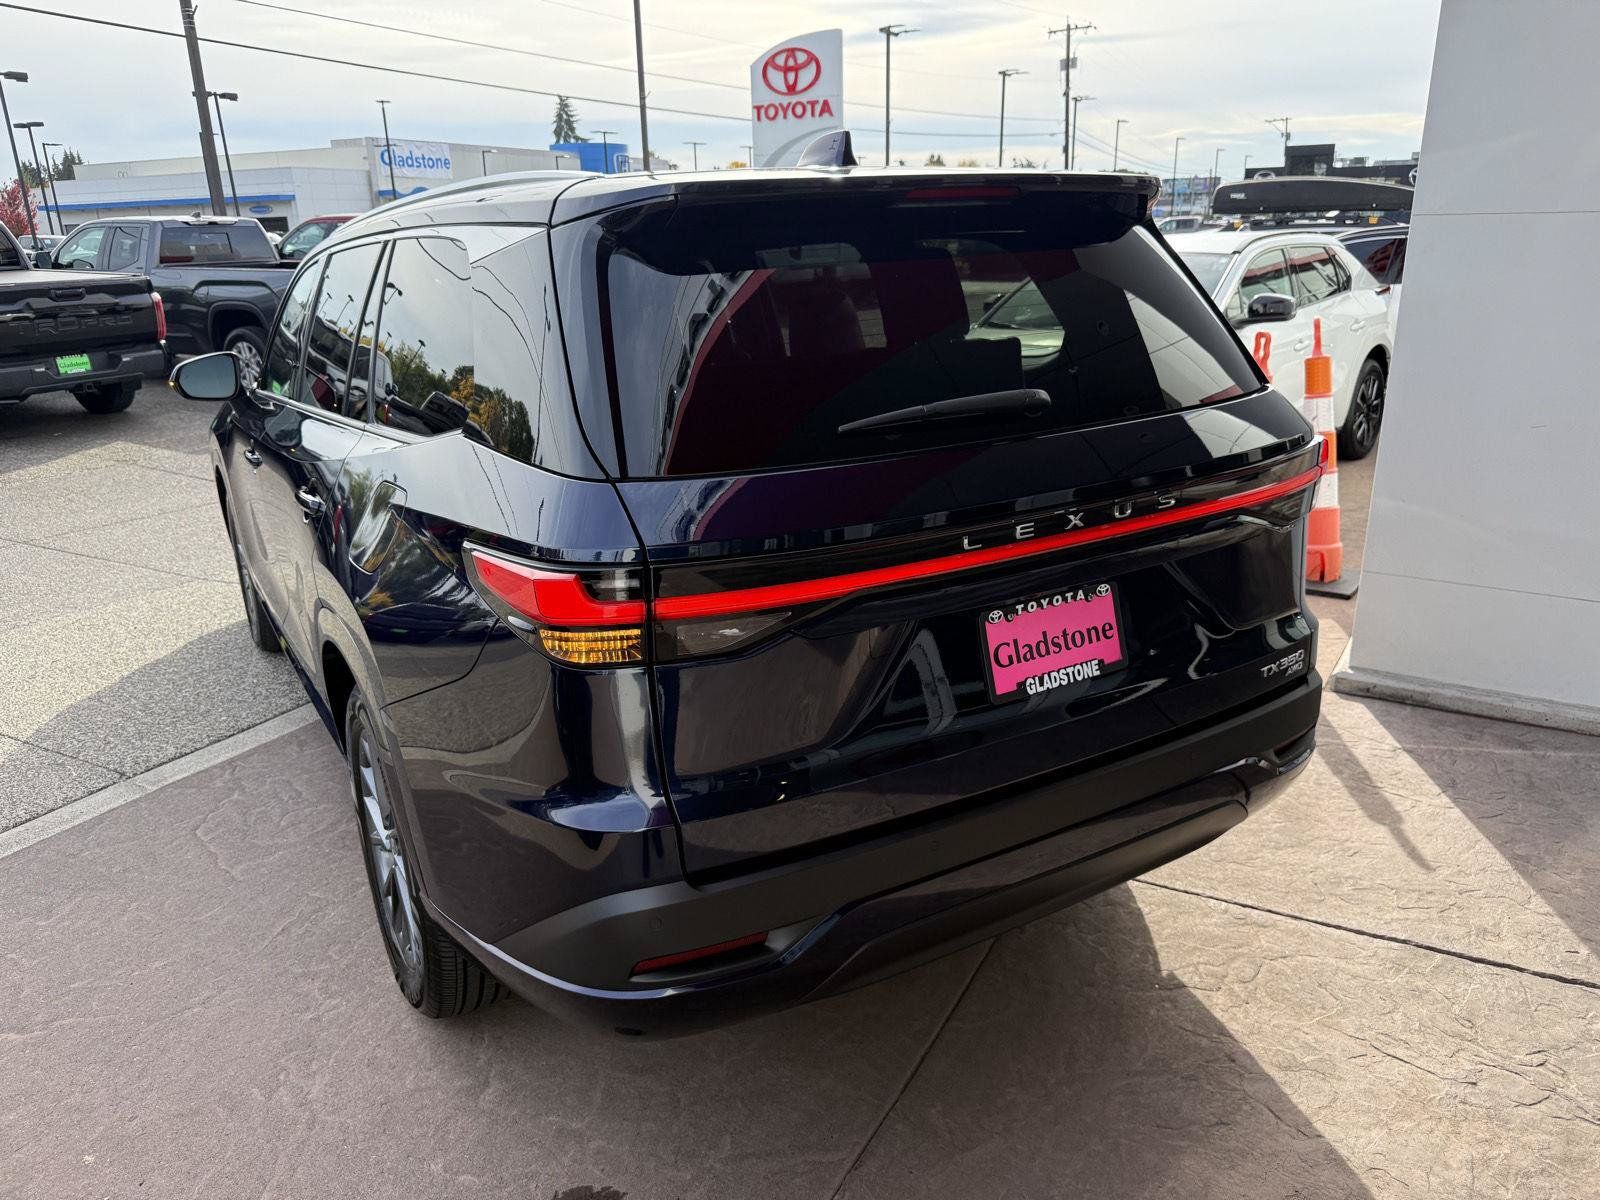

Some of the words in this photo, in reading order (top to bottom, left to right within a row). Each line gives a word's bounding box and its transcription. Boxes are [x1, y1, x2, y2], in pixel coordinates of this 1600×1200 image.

[753, 99, 833, 122] TOYOTA
[380, 148, 451, 170] Gladstone
[963, 494, 1176, 550] LEXUS
[1016, 590, 1085, 615] TOYOTA
[993, 621, 1114, 668] Gladstone
[1025, 659, 1100, 695] GLADSTONE
[1285, 661, 1303, 677] AWD
